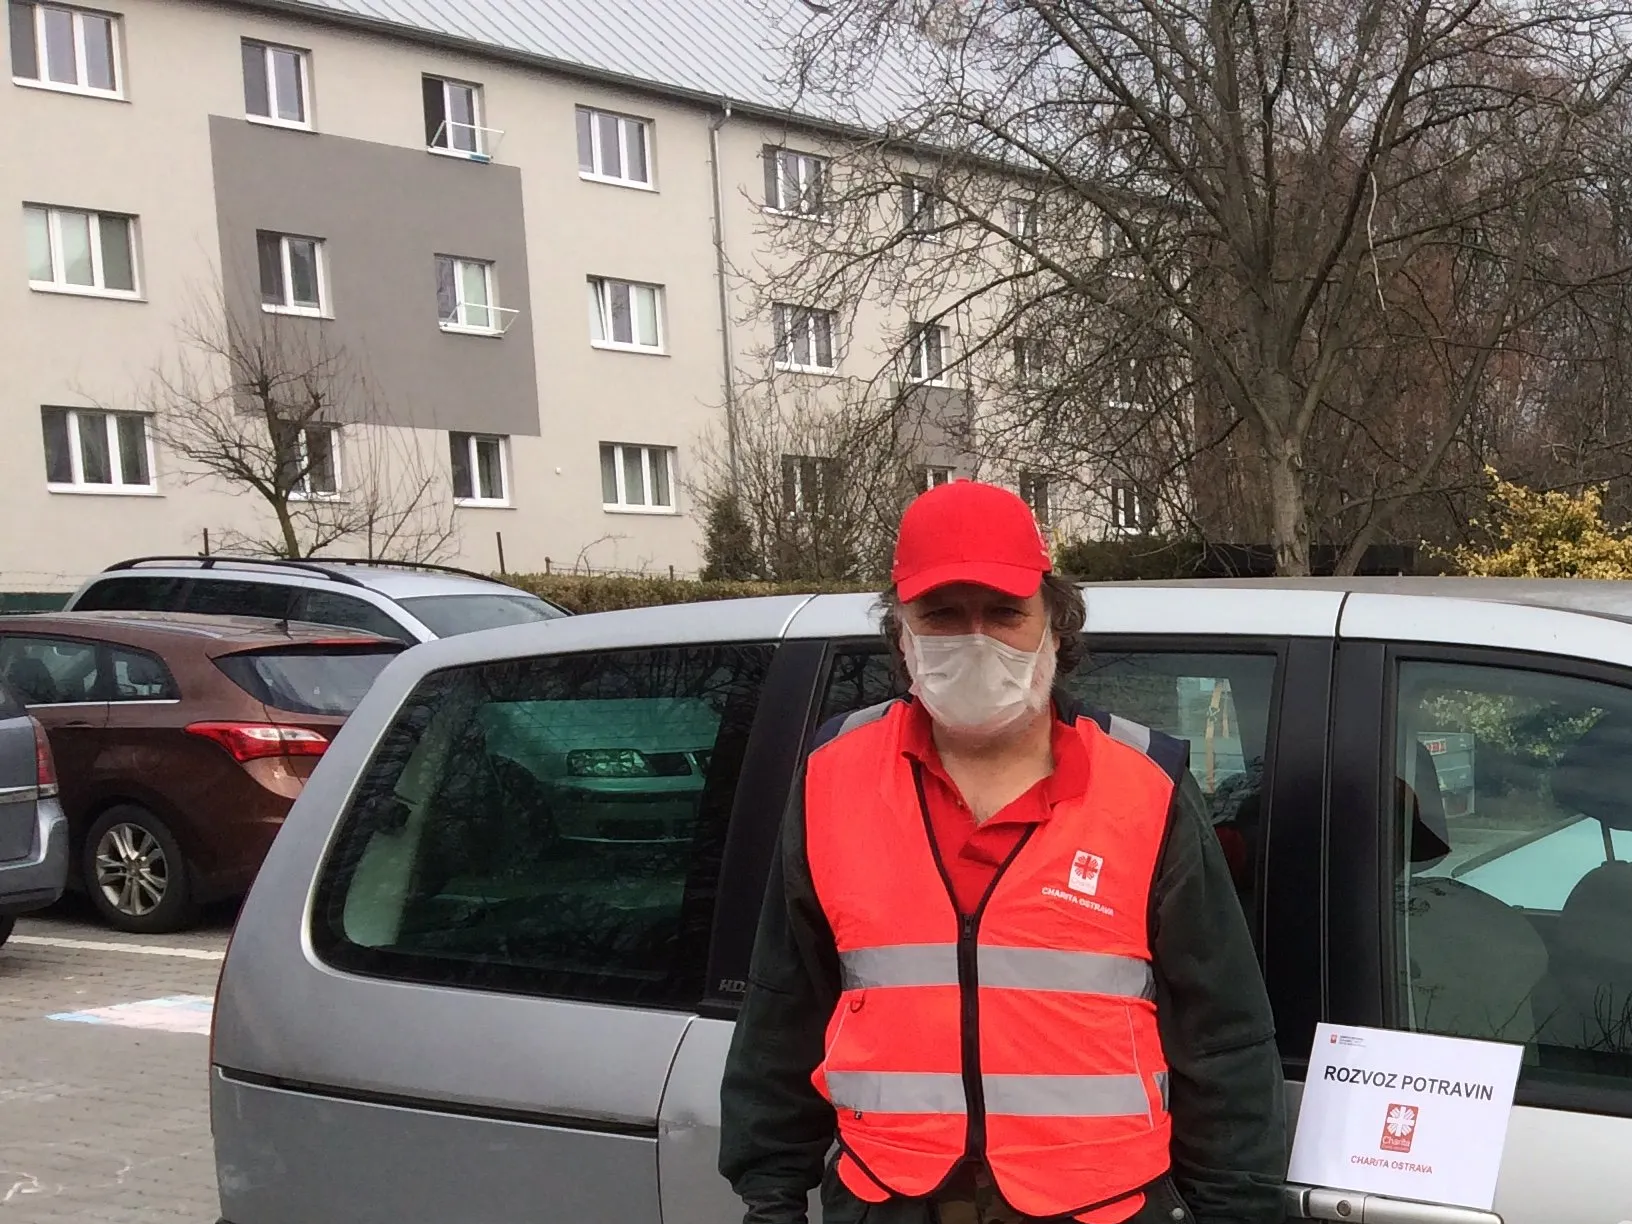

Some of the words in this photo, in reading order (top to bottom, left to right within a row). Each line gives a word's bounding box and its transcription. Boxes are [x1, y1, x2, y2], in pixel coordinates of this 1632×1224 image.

[1323, 1065, 1398, 1089] ROZVOZ
[1401, 1075, 1494, 1101] POTRAVIN
[1350, 1155, 1389, 1168] CHARITA
[1391, 1160, 1433, 1174] OSTRAVA
